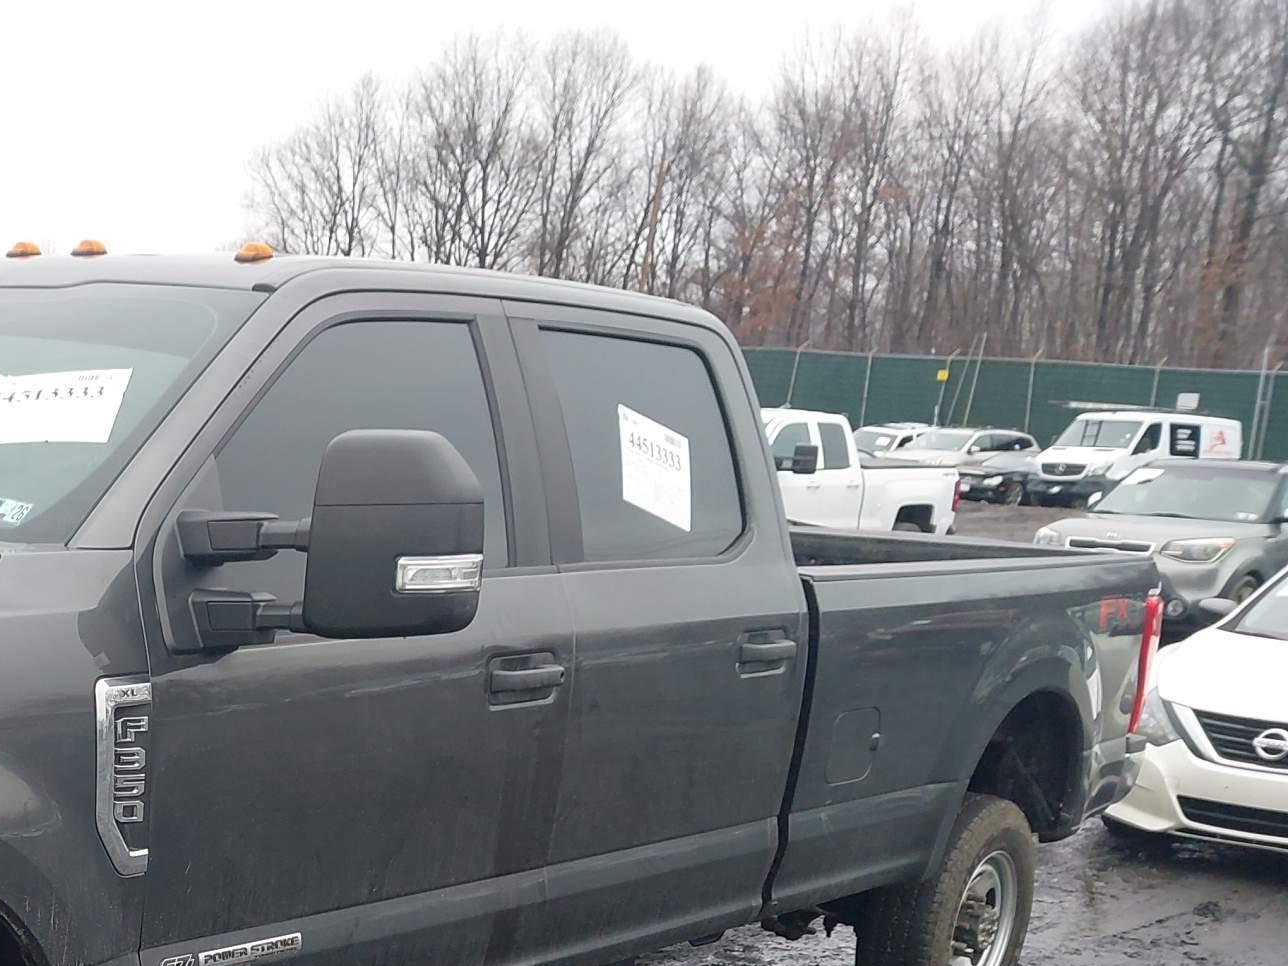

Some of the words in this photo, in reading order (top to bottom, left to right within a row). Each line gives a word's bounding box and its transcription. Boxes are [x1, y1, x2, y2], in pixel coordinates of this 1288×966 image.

[628, 431, 682, 472] 44513333
[121, 688, 138, 698] XL
[204, 948, 249, 965] POWER
[251, 936, 300, 953] STROKE
